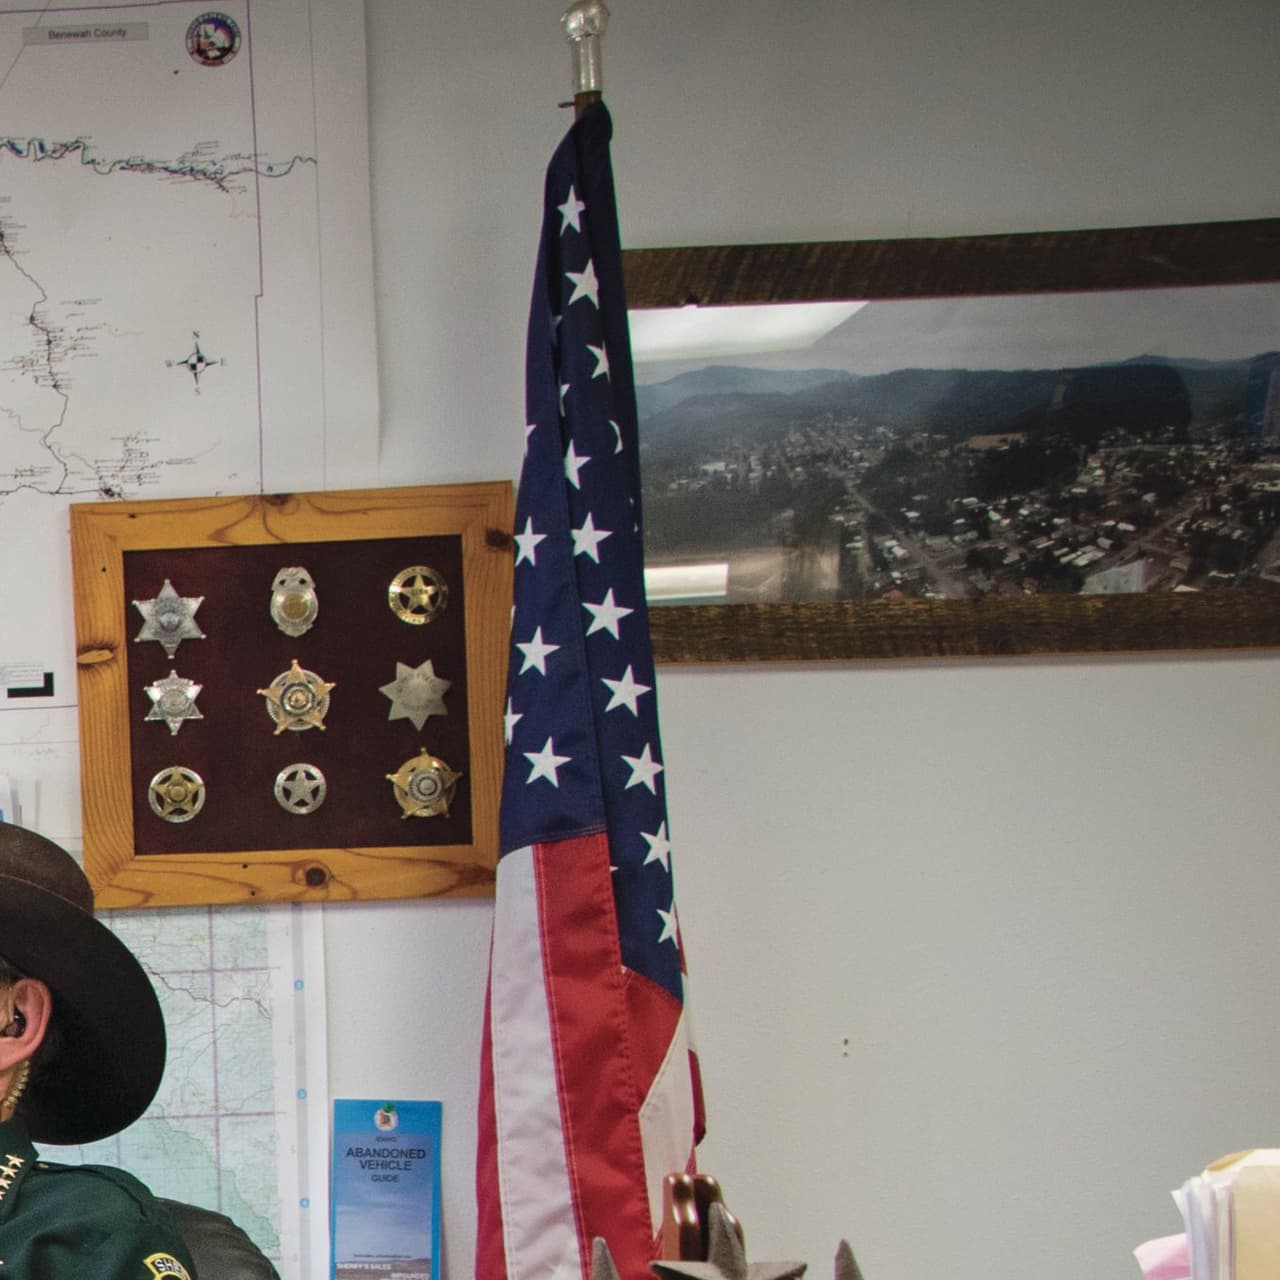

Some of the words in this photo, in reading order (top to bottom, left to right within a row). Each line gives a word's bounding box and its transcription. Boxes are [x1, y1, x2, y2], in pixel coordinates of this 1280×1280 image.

[48, 28, 90, 40] Benewah
[93, 27, 126, 39] County
[193, 331, 200, 339] N
[166, 360, 176, 368] W
[194, 387, 201, 395] S
[345, 1148, 427, 1159] ABANDONED
[359, 1160, 412, 1171] VEHICLE
[371, 1173, 400, 1183] GUIDE
